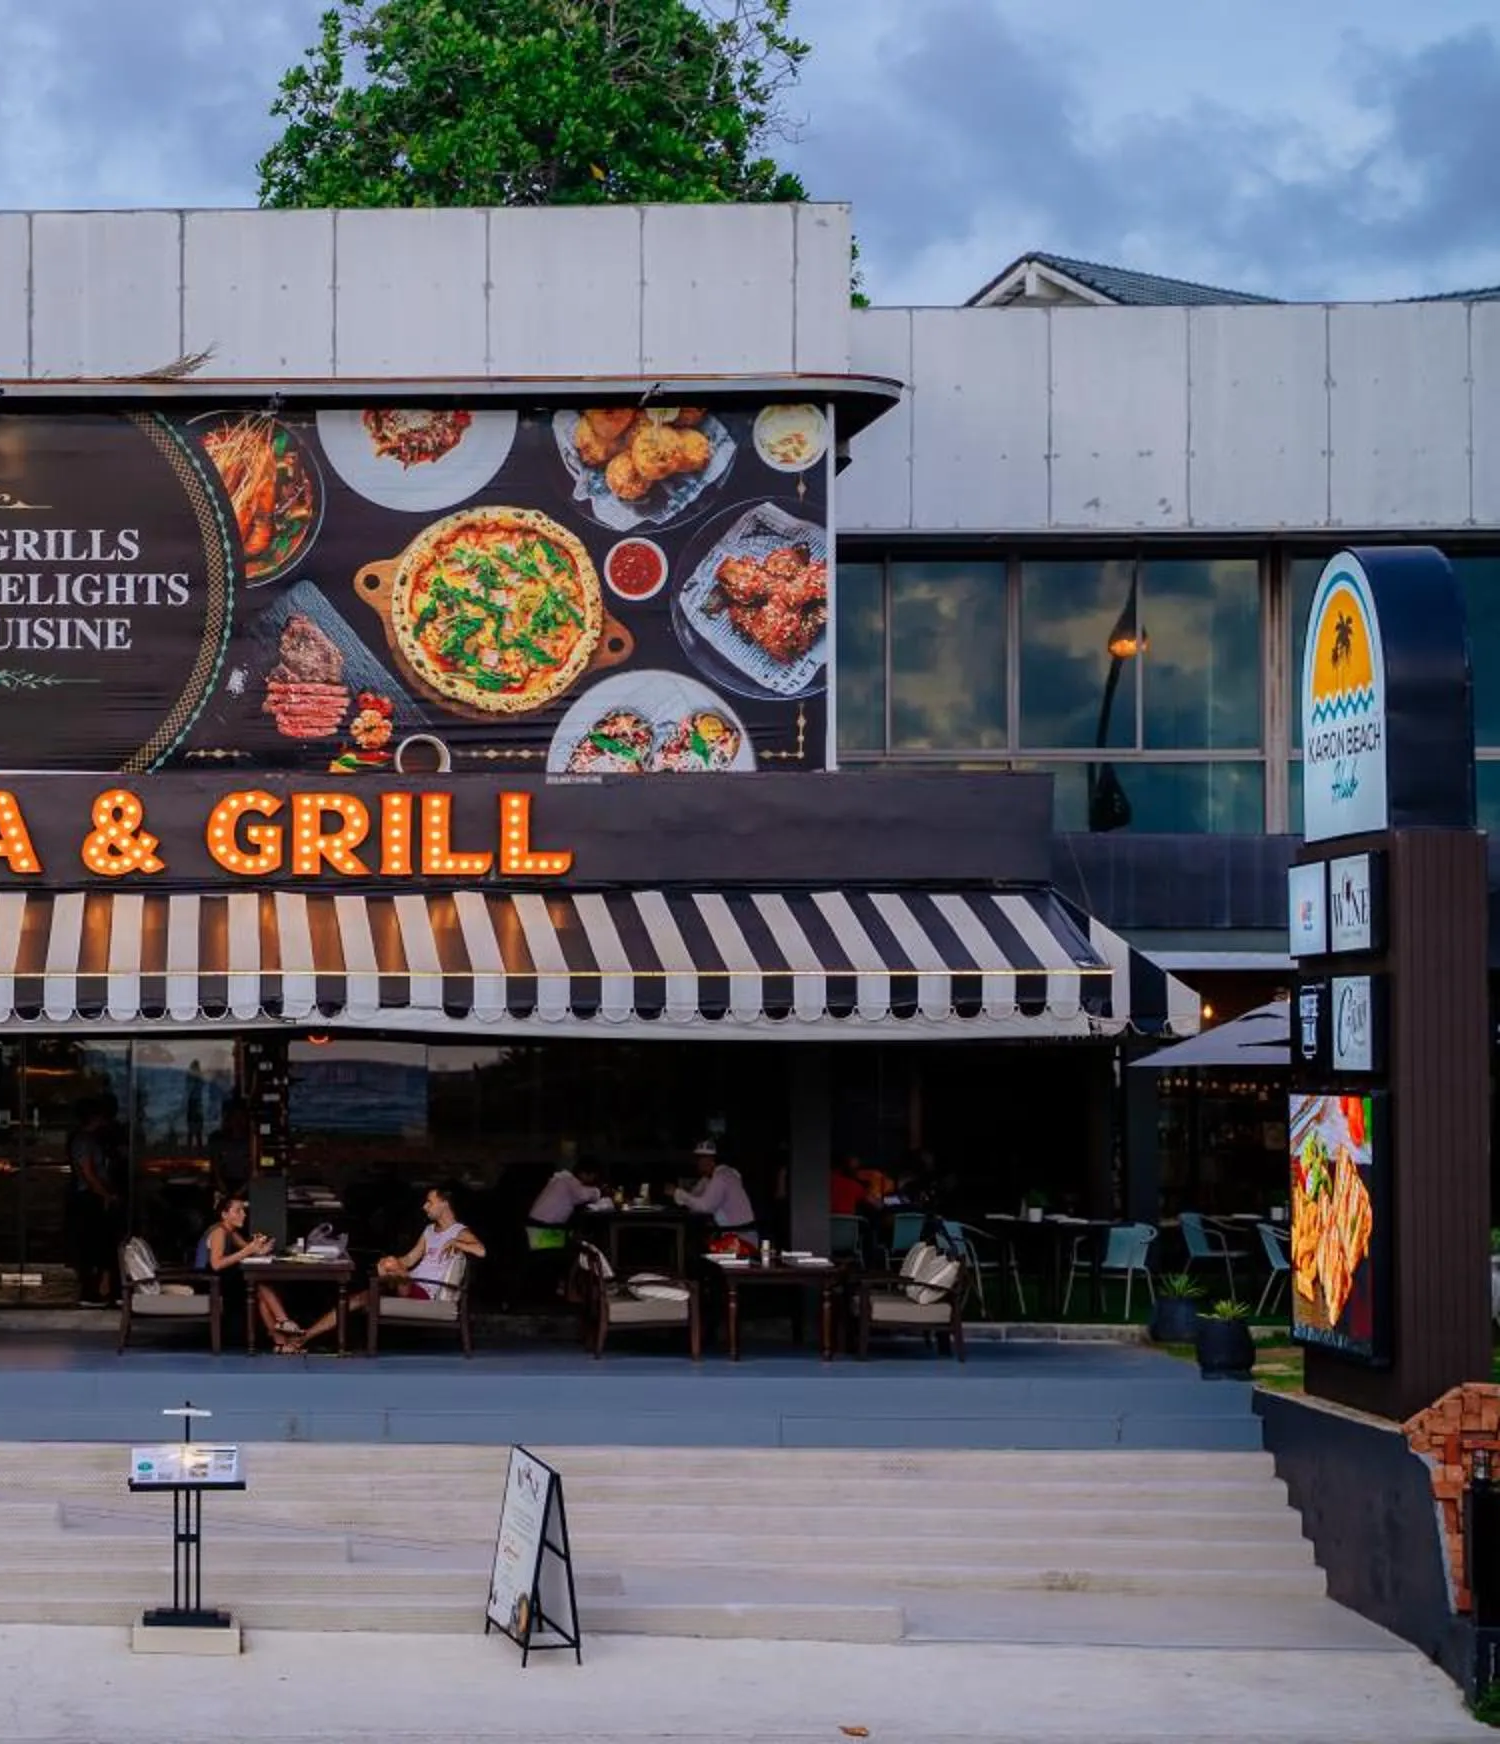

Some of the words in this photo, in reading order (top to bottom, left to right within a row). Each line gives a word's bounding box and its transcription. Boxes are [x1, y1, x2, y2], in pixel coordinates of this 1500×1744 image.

[1308, 729, 1345, 765] KARON
[1347, 723, 1381, 755] BEACH
[81, 788, 167, 877] &
[207, 790, 574, 876] GRILL
